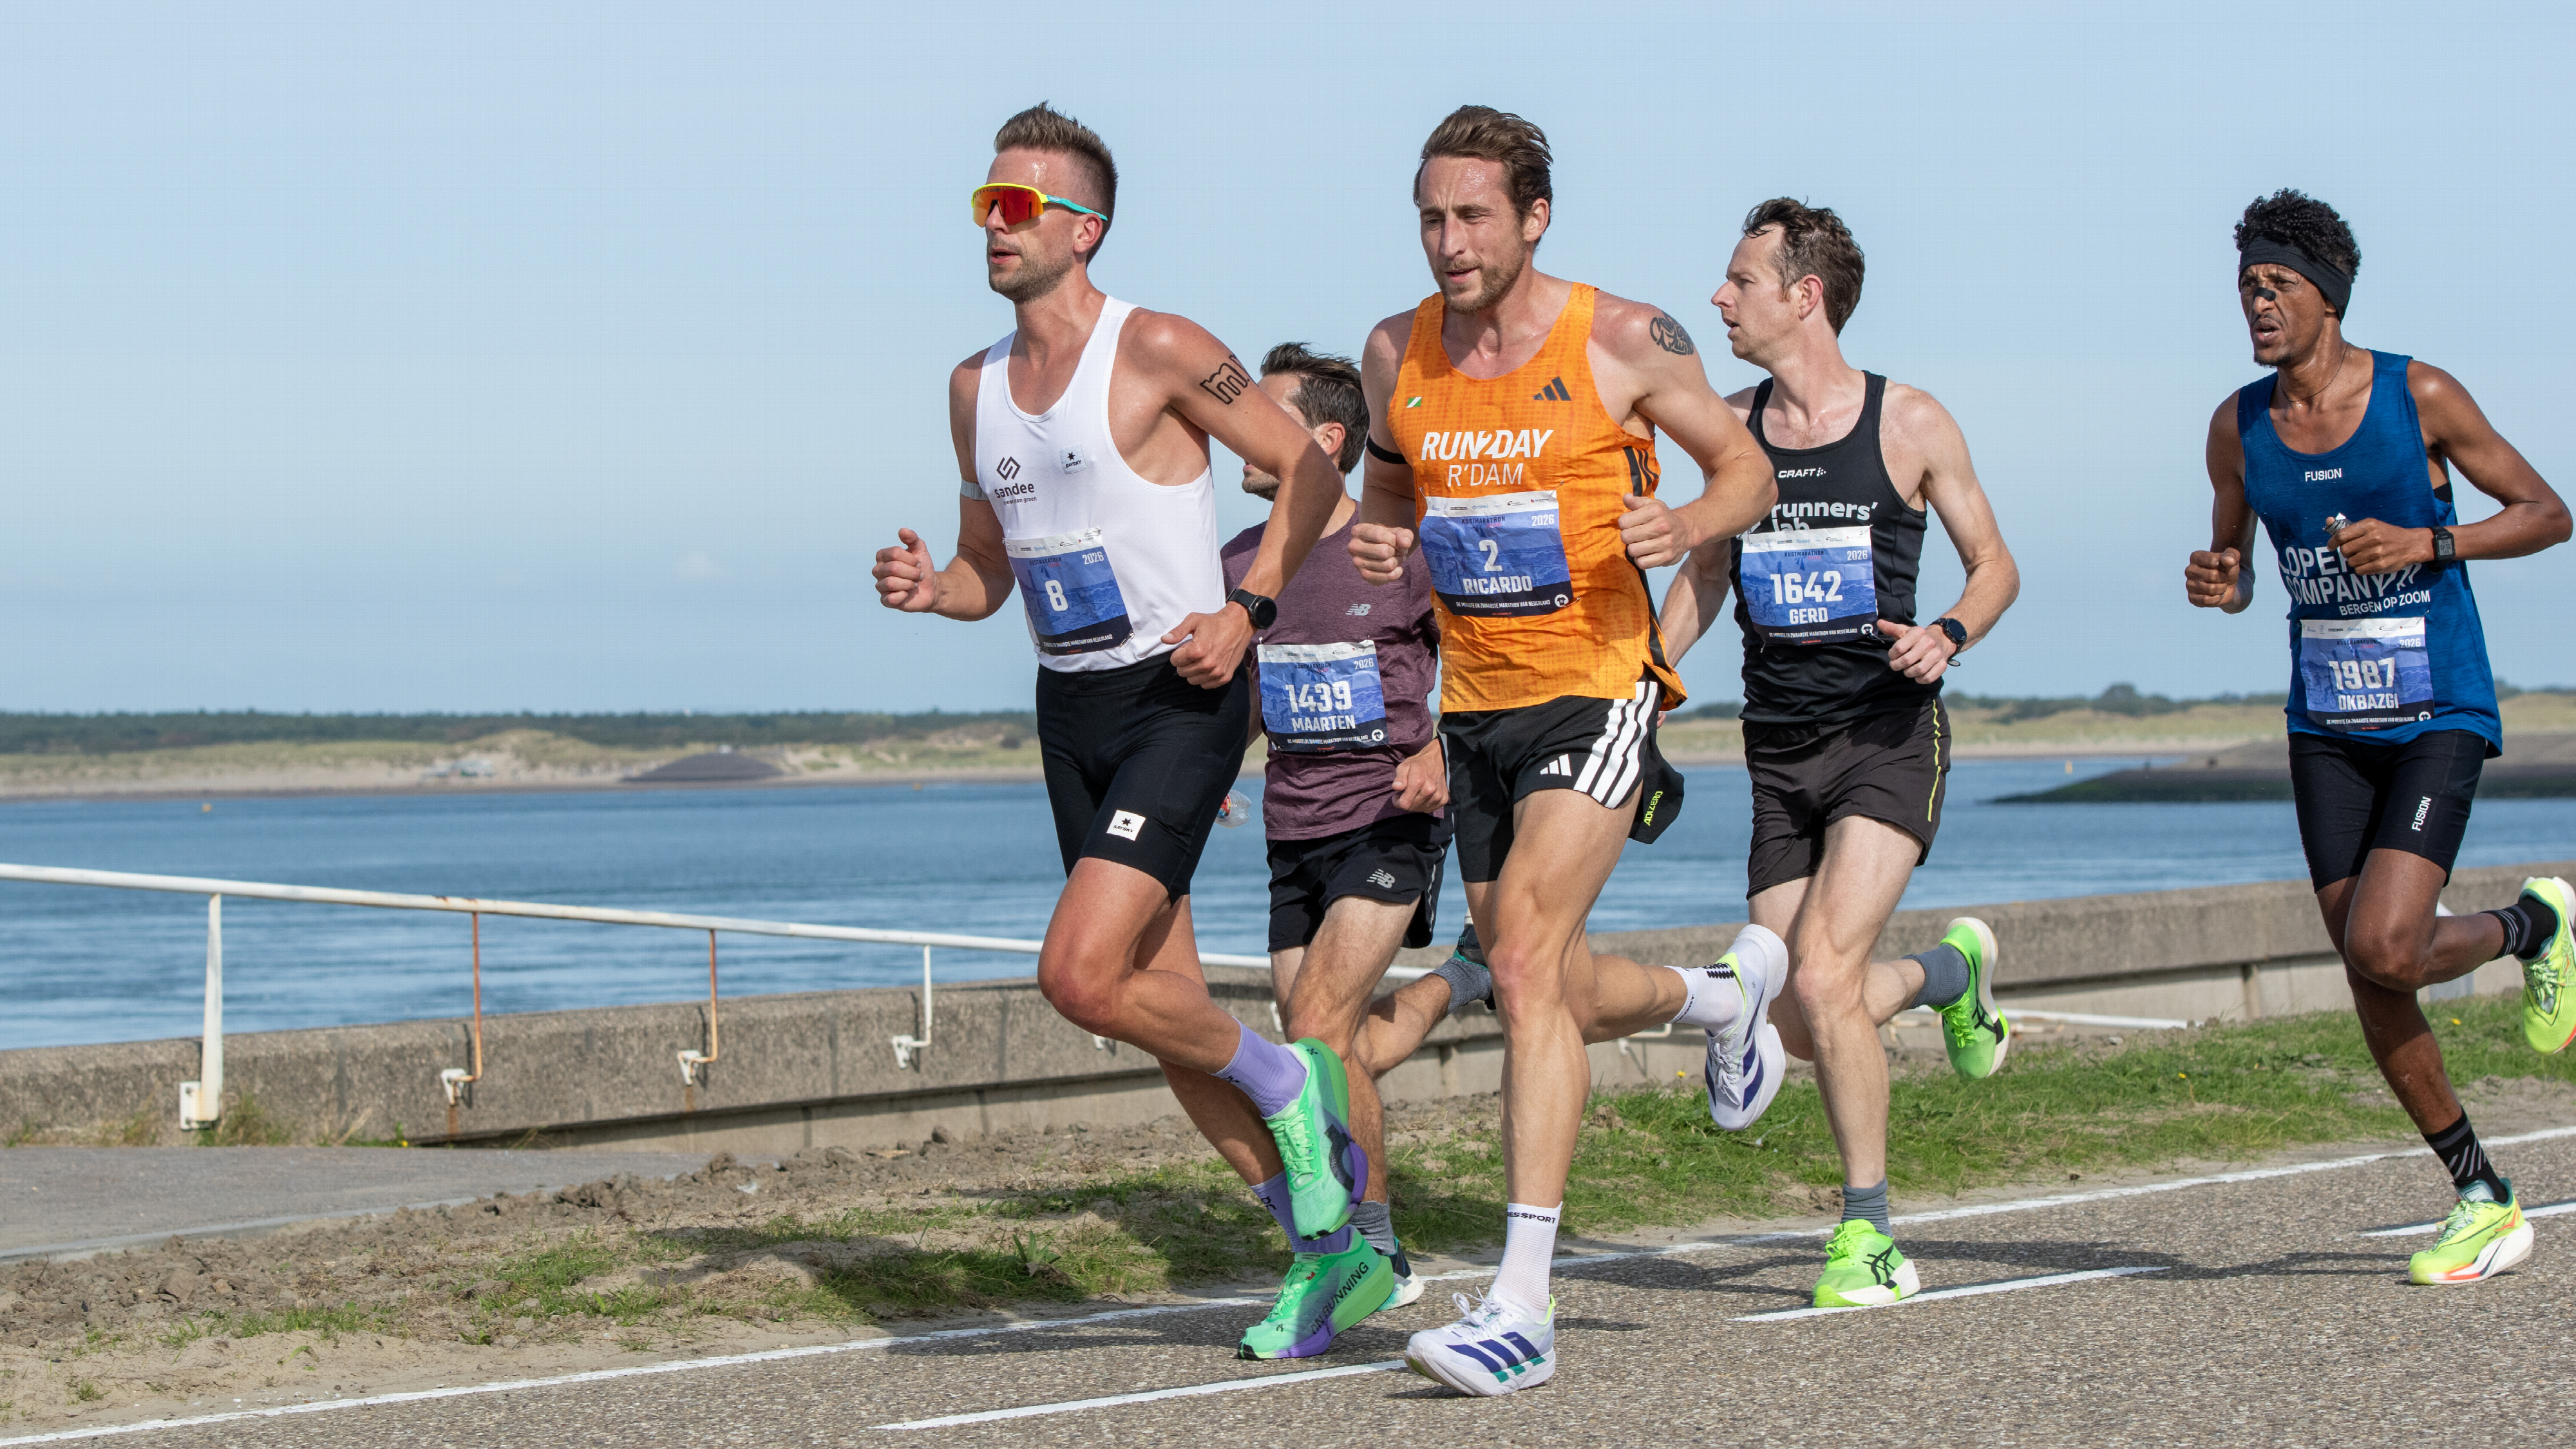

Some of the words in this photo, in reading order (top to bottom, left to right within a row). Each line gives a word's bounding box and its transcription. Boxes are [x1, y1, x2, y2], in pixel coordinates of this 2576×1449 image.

[1421, 429, 1553, 461] RUN2DAY
[1065, 459, 1082, 468] SAYSKY
[1777, 468, 1816, 478] CRAFT
[2305, 468, 2342, 482] FUSION
[994, 482, 1035, 498] sandee
[1531, 514, 1555, 527] 2026
[1082, 551, 1104, 565] 2026
[1479, 540, 1502, 572] 2
[1846, 549, 1868, 561] 2026
[1463, 575, 1533, 594] RICARDO
[1770, 570, 1843, 605] 1642
[1045, 580, 1068, 612] 8
[2339, 601, 2383, 616] BERGEN
[2383, 596, 2398, 609] OP
[2399, 590, 2430, 607] ZOOM
[1789, 607, 1829, 625] GERD
[2399, 638, 2421, 648] 2026
[1354, 658, 1374, 670] 2026
[2328, 657, 2396, 690] 1987
[1285, 681, 1352, 713] 1439
[2338, 693, 2400, 711] OKBAZGI
[1291, 714, 1356, 732] MAARTEN
[1643, 791, 1663, 827] ADIZERO
[2411, 795, 2432, 831] FUSION
[1112, 824, 1134, 833] SAYSKY
[1311, 1314, 1325, 1335] ON
[1321, 1262, 1369, 1318] RUNNING
